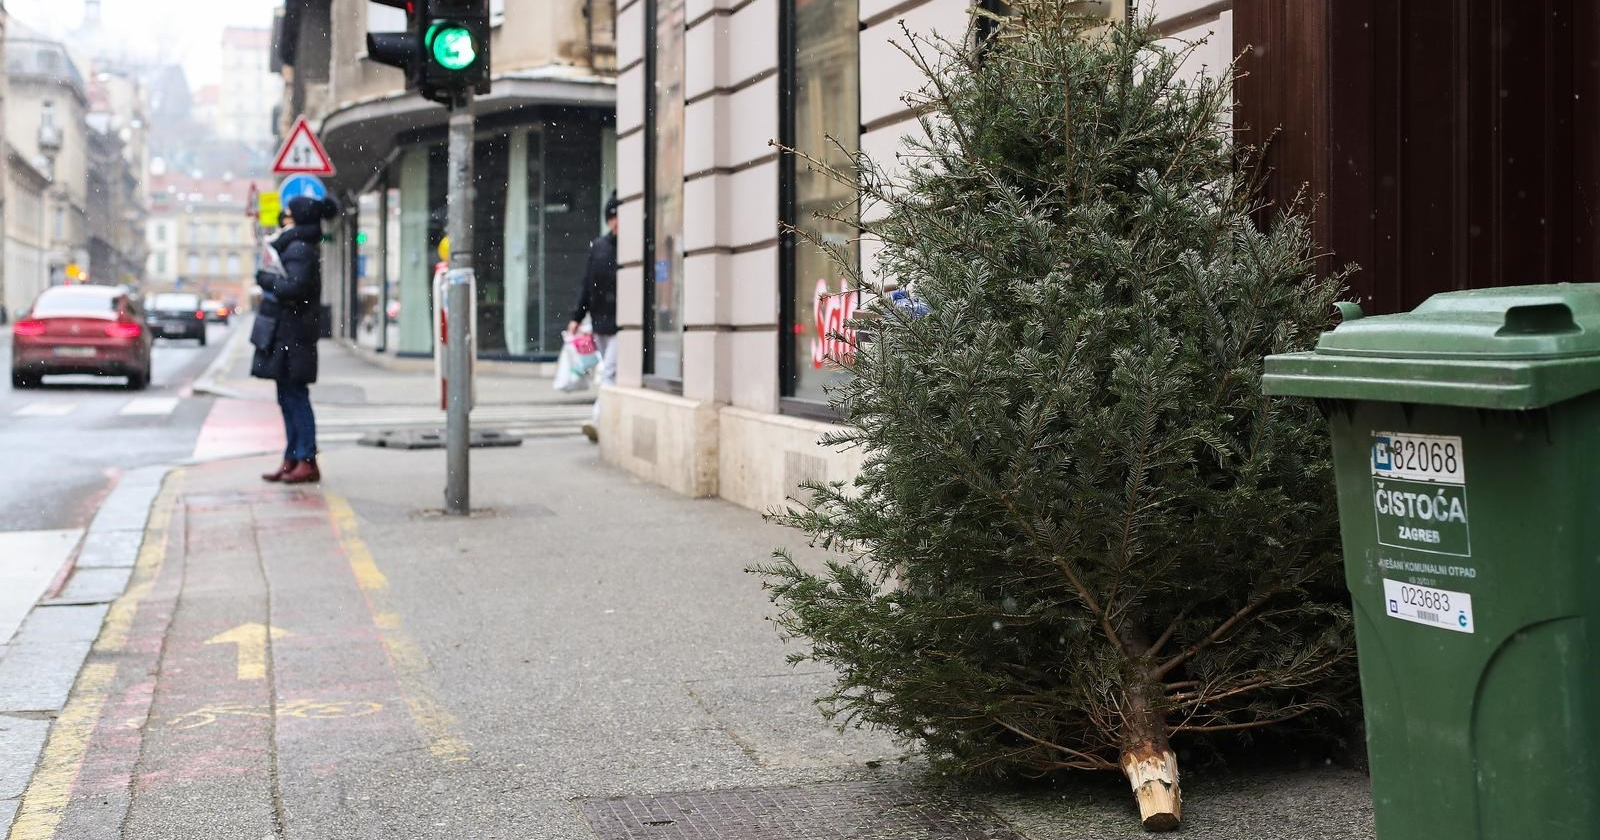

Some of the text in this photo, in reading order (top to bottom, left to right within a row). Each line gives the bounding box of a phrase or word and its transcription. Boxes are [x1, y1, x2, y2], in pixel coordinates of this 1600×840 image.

[1394, 440, 1457, 474] 82068
[1376, 482, 1467, 523] ČISTOĆA
[1398, 525, 1441, 543] ZAGREB
[1405, 561, 1447, 575] KOMUNALNI
[1448, 566, 1476, 578] OTPAD
[1401, 586, 1450, 612] 023683
